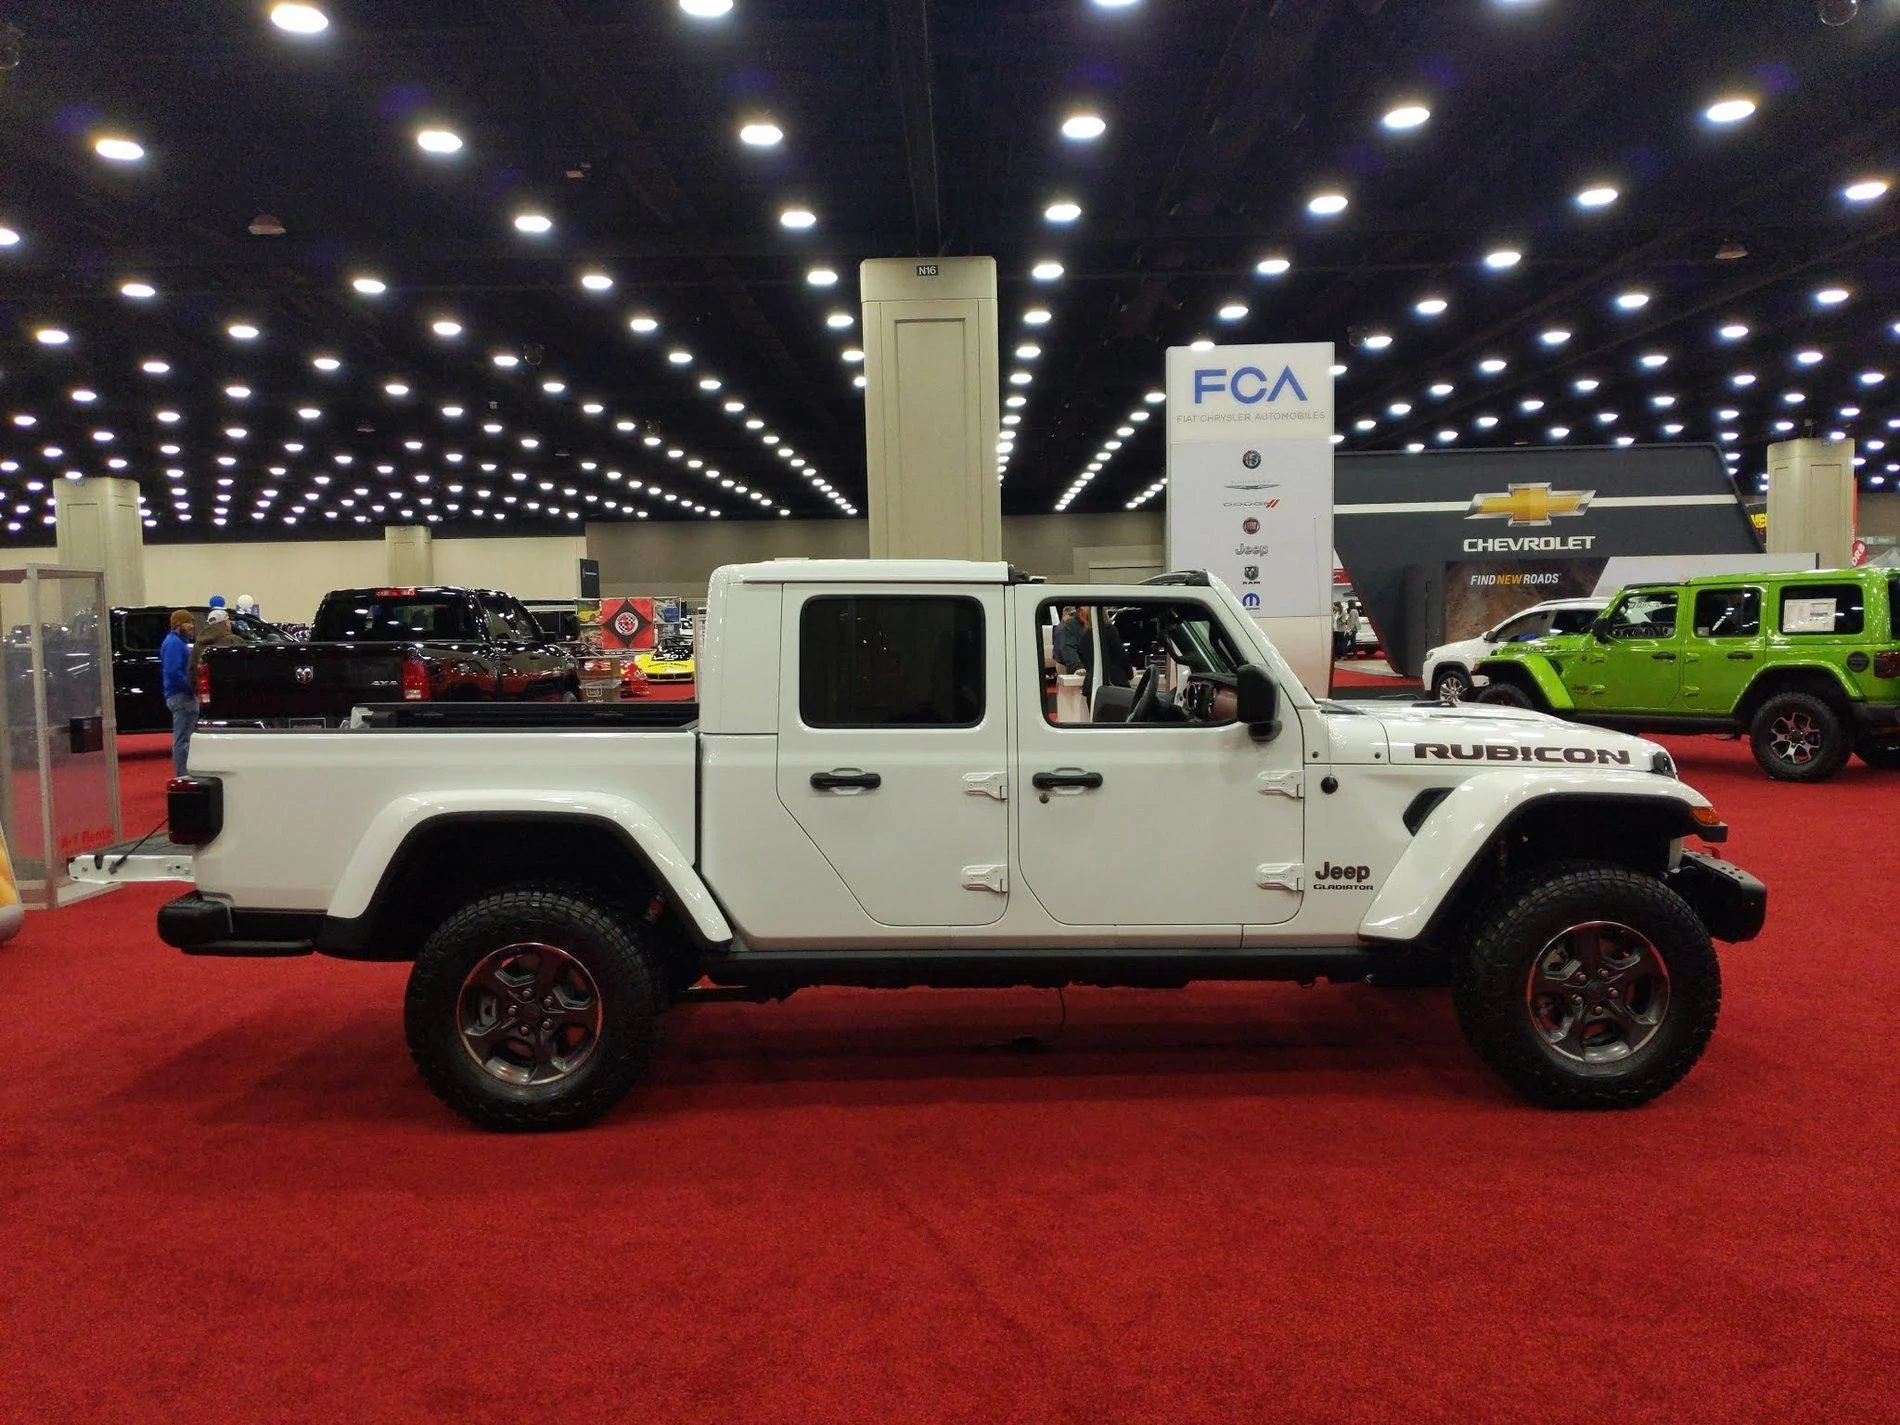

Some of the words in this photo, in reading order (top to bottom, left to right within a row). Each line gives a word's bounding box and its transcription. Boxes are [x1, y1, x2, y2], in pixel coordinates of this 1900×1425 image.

[918, 266, 937, 275] N16
[1194, 364, 1308, 404] FCA
[1176, 414, 1199, 424] FIAT
[1200, 413, 1250, 423] CHRYSLER
[1254, 411, 1326, 421] AUTOMOBILES
[1234, 543, 1269, 556] Jeep
[1463, 535, 1596, 552] CHEVROLET
[1470, 574, 1496, 585] FIND
[1496, 573, 1524, 585] NEW
[1523, 573, 1560, 584] ROADS
[1414, 742, 1630, 765] RUBICON
[1315, 861, 1370, 883] Jeep
